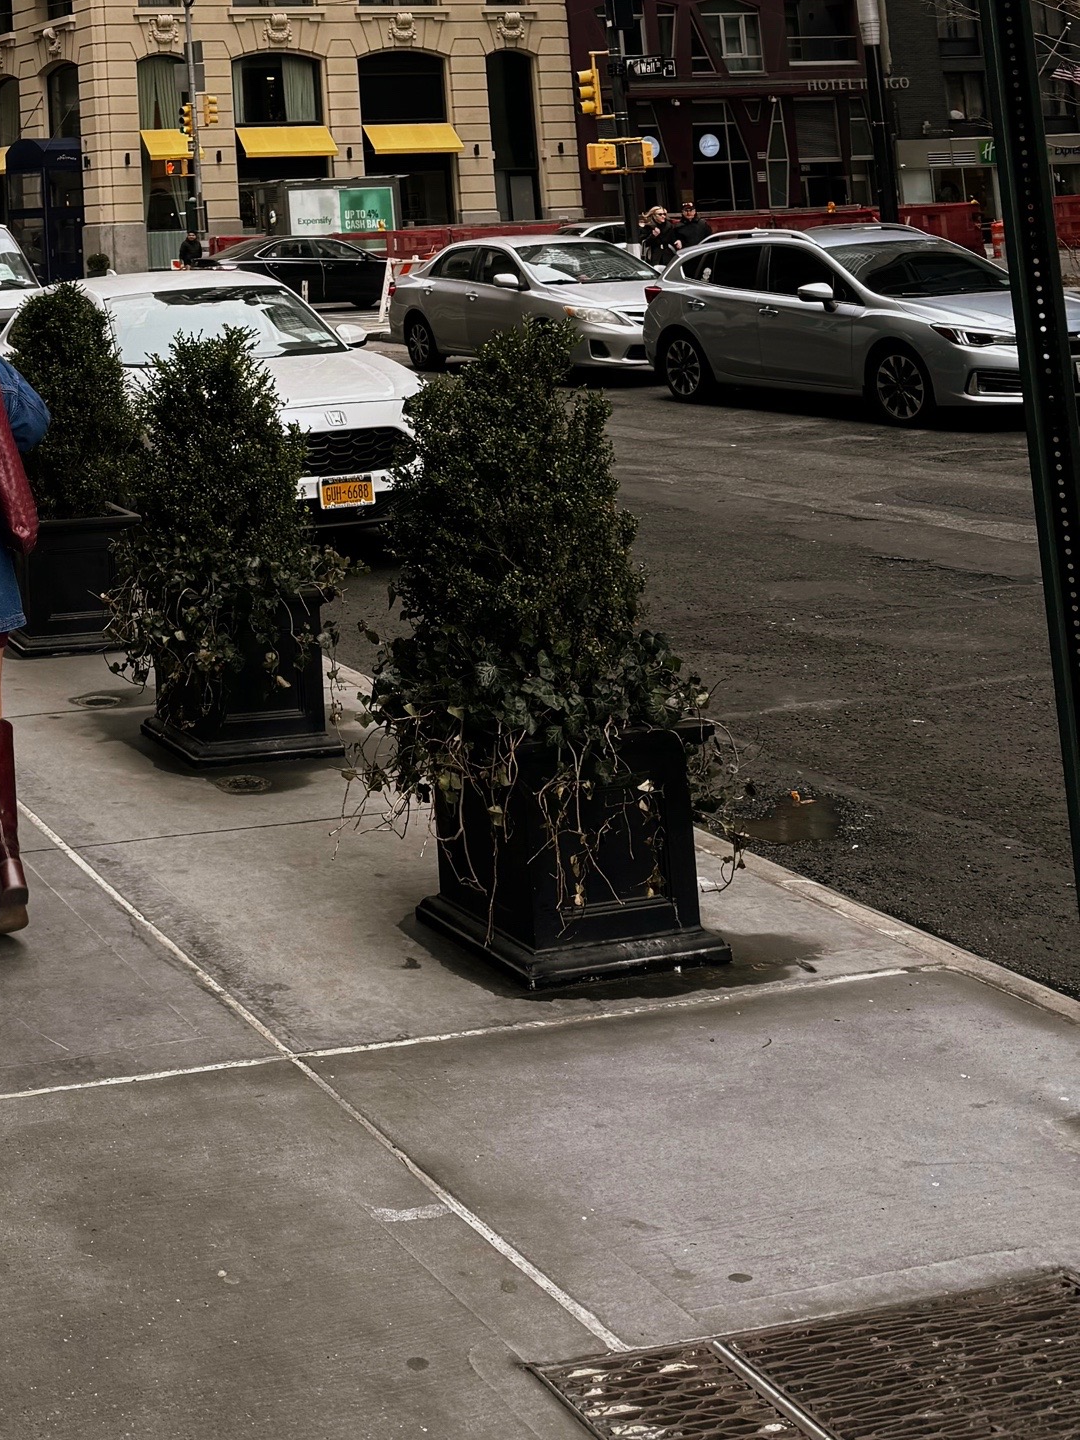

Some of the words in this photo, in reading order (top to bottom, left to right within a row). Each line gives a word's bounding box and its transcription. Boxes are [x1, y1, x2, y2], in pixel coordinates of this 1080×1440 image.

[640, 62, 656, 74] Wall
[807, 79, 856, 91] HOTEL
[860, 77, 910, 90] IIGO
[344, 210, 355, 220] UP
[356, 210, 366, 219] TO
[367, 209, 379, 219] 4%
[297, 216, 333, 226] Expensify
[345, 220, 366, 230] CASH
